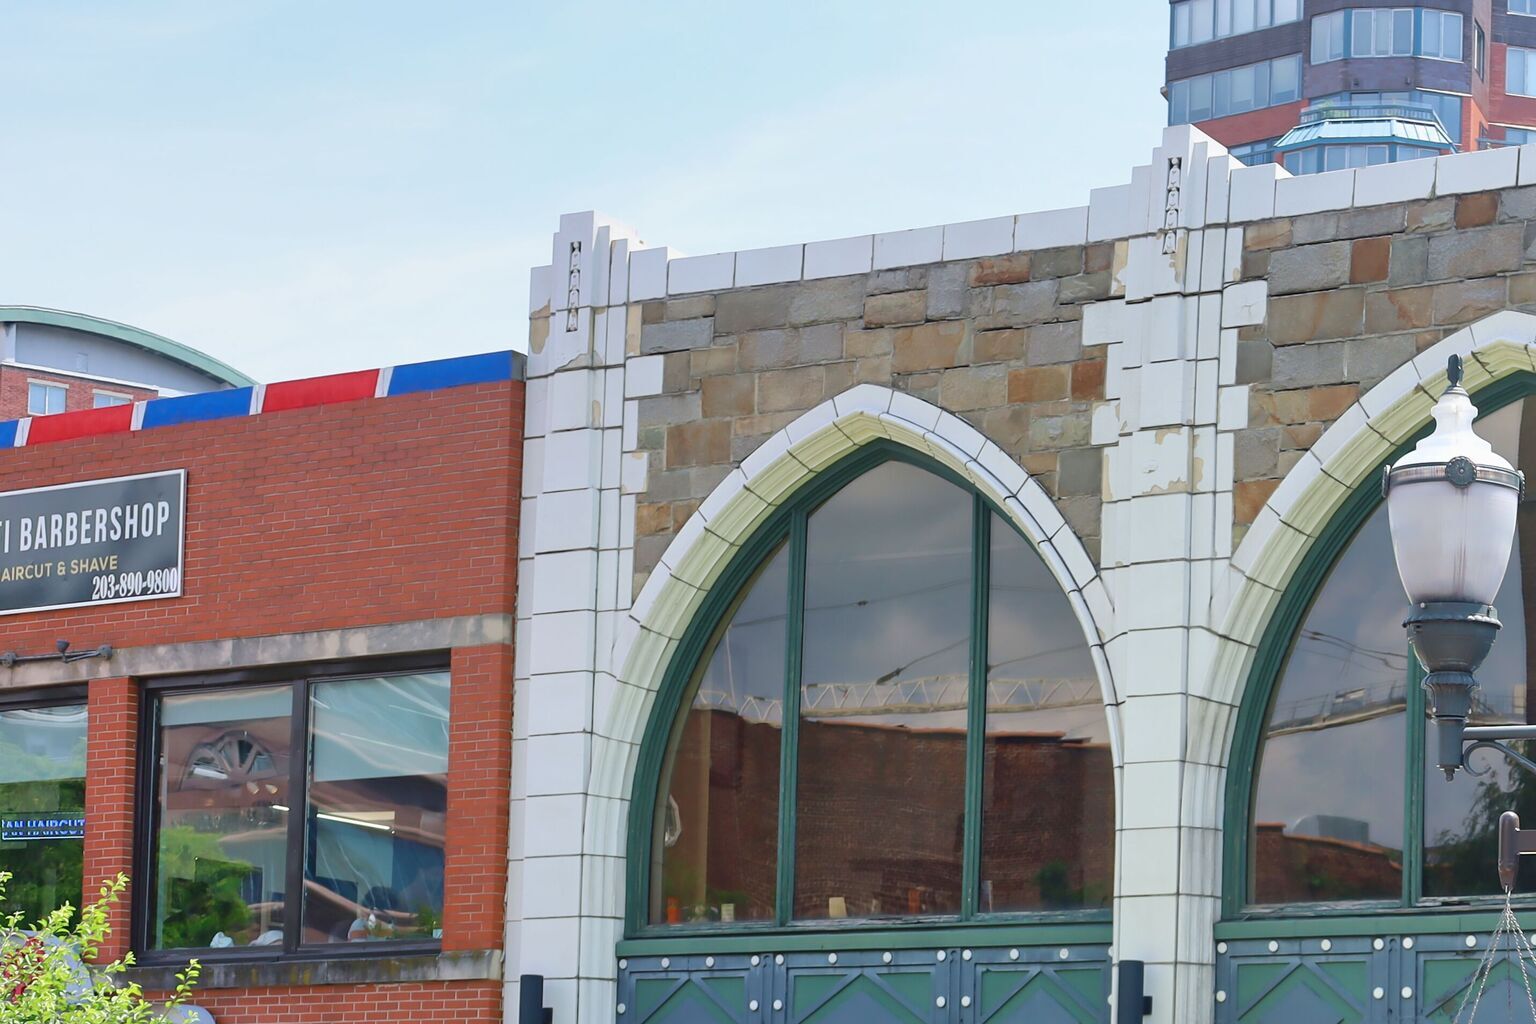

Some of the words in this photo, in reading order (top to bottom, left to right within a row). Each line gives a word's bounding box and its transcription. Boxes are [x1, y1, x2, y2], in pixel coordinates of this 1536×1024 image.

[20, 501, 170, 551] BARBERSHOP
[57, 561, 66, 576] &
[70, 555, 118, 574] SHAVE
[92, 567, 178, 600] 203-890-9800
